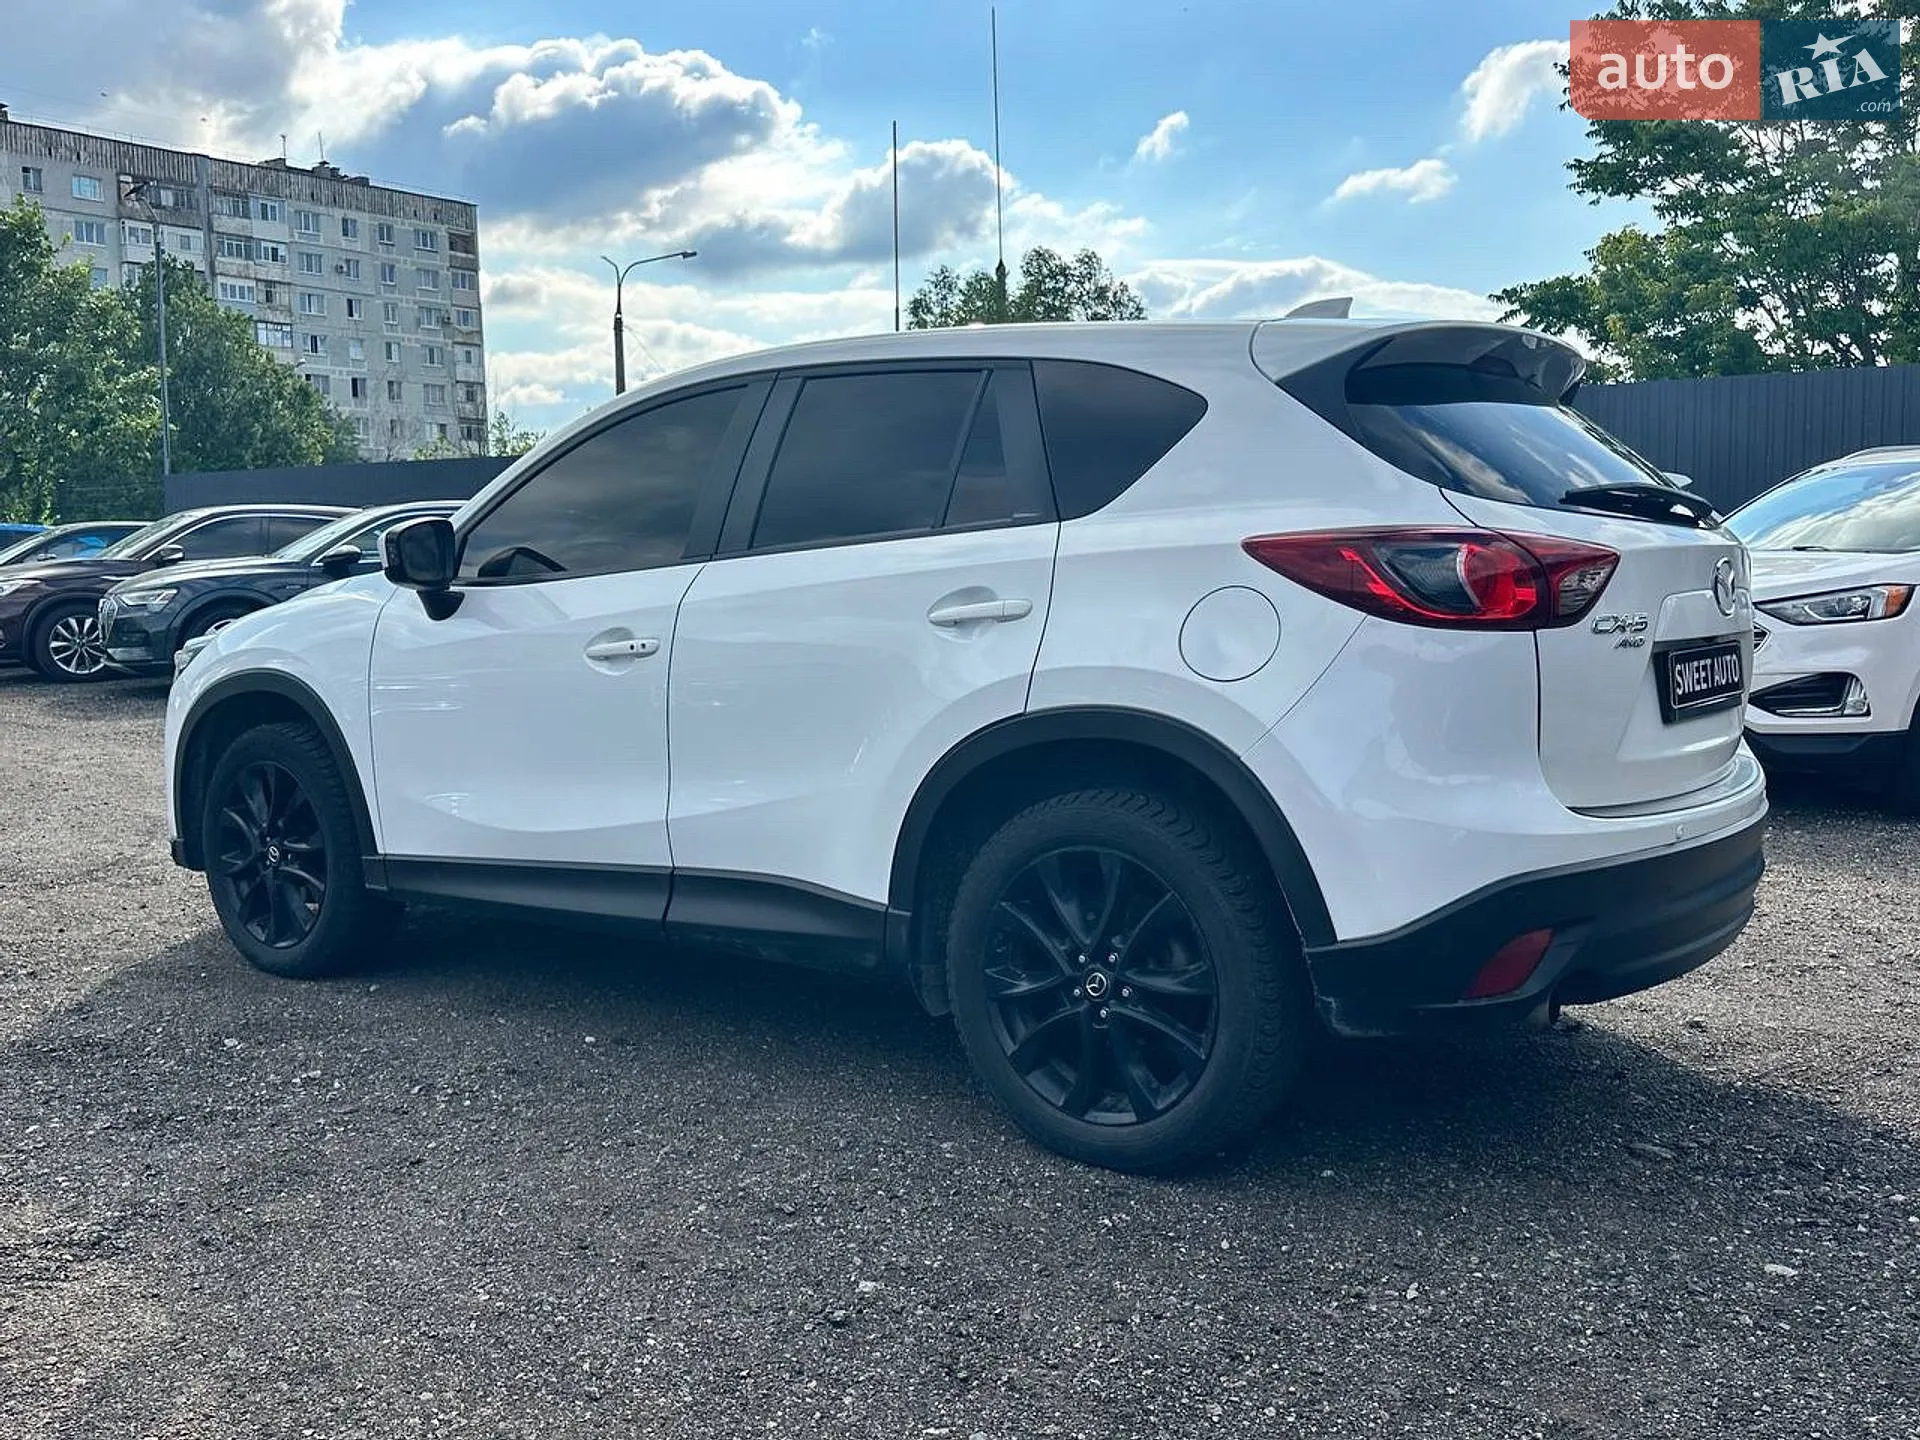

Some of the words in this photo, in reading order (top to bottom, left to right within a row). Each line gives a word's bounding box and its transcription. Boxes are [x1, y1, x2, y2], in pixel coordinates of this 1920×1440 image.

[1592, 612, 1648, 634] CX-5
[1611, 635, 1646, 649] AWD
[1675, 658, 1713, 696] SWEET
[1713, 653, 1741, 687] AUTO
